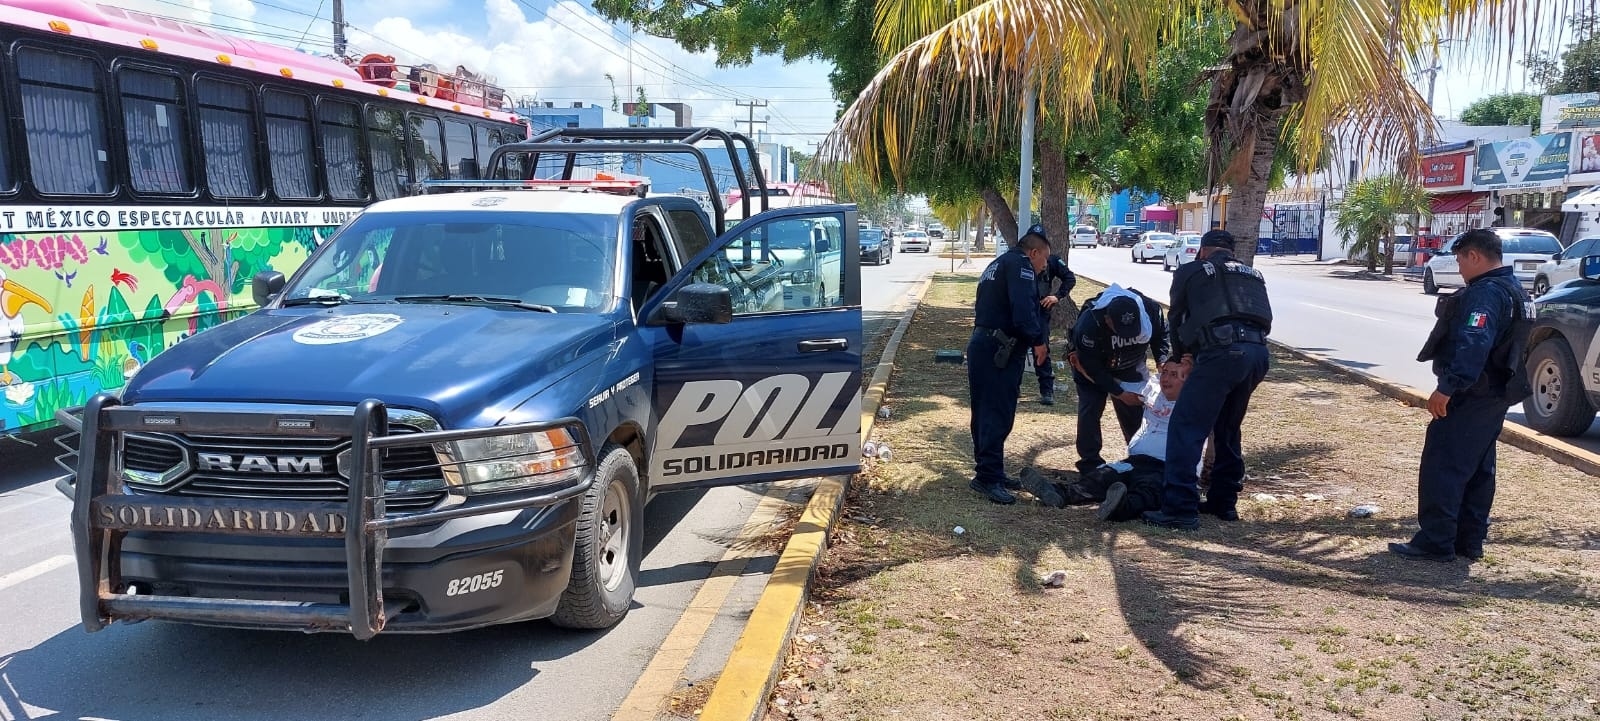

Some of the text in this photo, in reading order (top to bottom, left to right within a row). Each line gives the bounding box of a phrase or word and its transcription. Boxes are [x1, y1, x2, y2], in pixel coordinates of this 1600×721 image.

[26, 208, 111, 228] MÉXICO
[118, 211, 244, 226] ESPECTACULAR
[260, 211, 309, 225] AVIARY
[610, 384, 616, 396] Y
[197, 452, 323, 473] RAM
[663, 443, 850, 477] SOLIDARIDAD
[100, 505, 347, 533] SOLIDARIDAD
[446, 569, 505, 597] 82055
